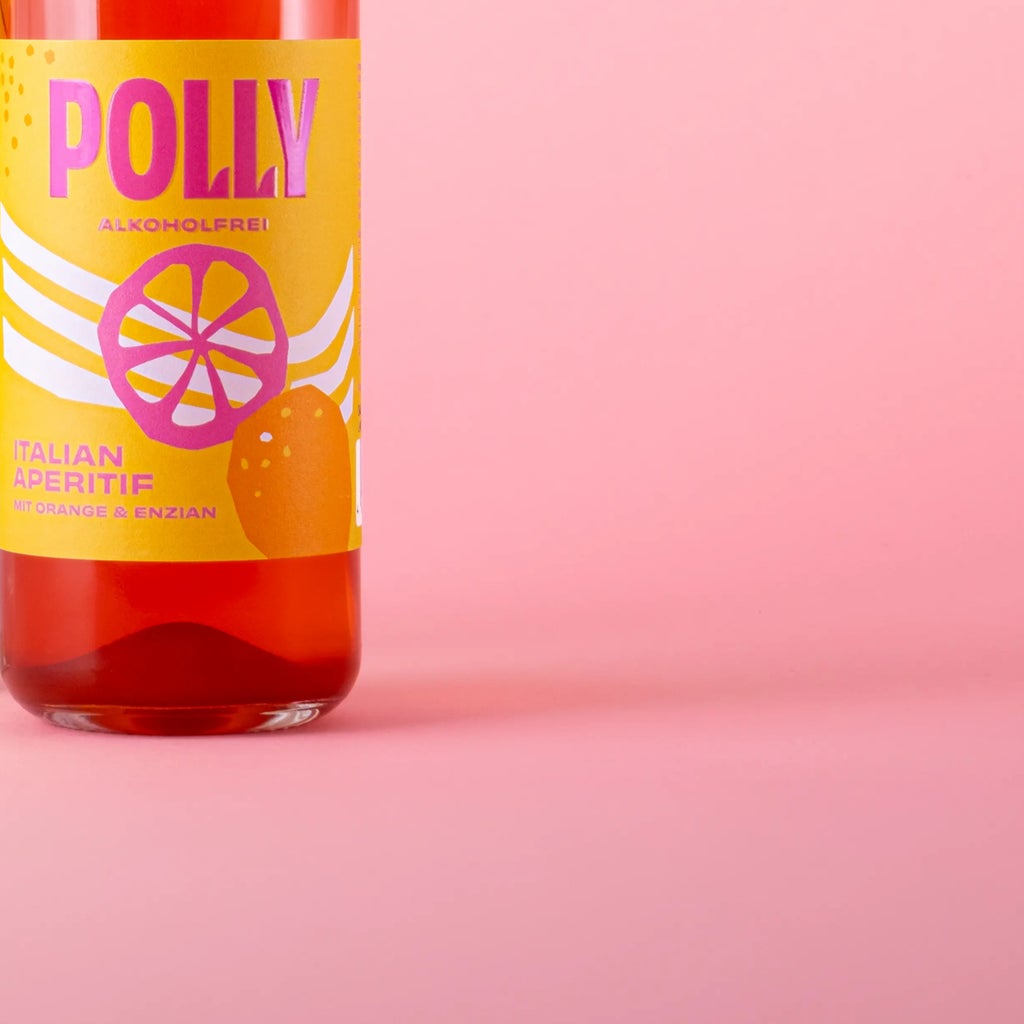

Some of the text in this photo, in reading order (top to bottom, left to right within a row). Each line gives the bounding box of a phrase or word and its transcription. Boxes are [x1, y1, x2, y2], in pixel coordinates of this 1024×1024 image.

[49, 78, 320, 201] POLLY
[97, 217, 269, 233] ALKOHOLFREI
[14, 439, 124, 468] ITALIAN
[13, 466, 154, 496] APERITIF
[13, 499, 217, 519] MIT ORANGE & ENZIAN
